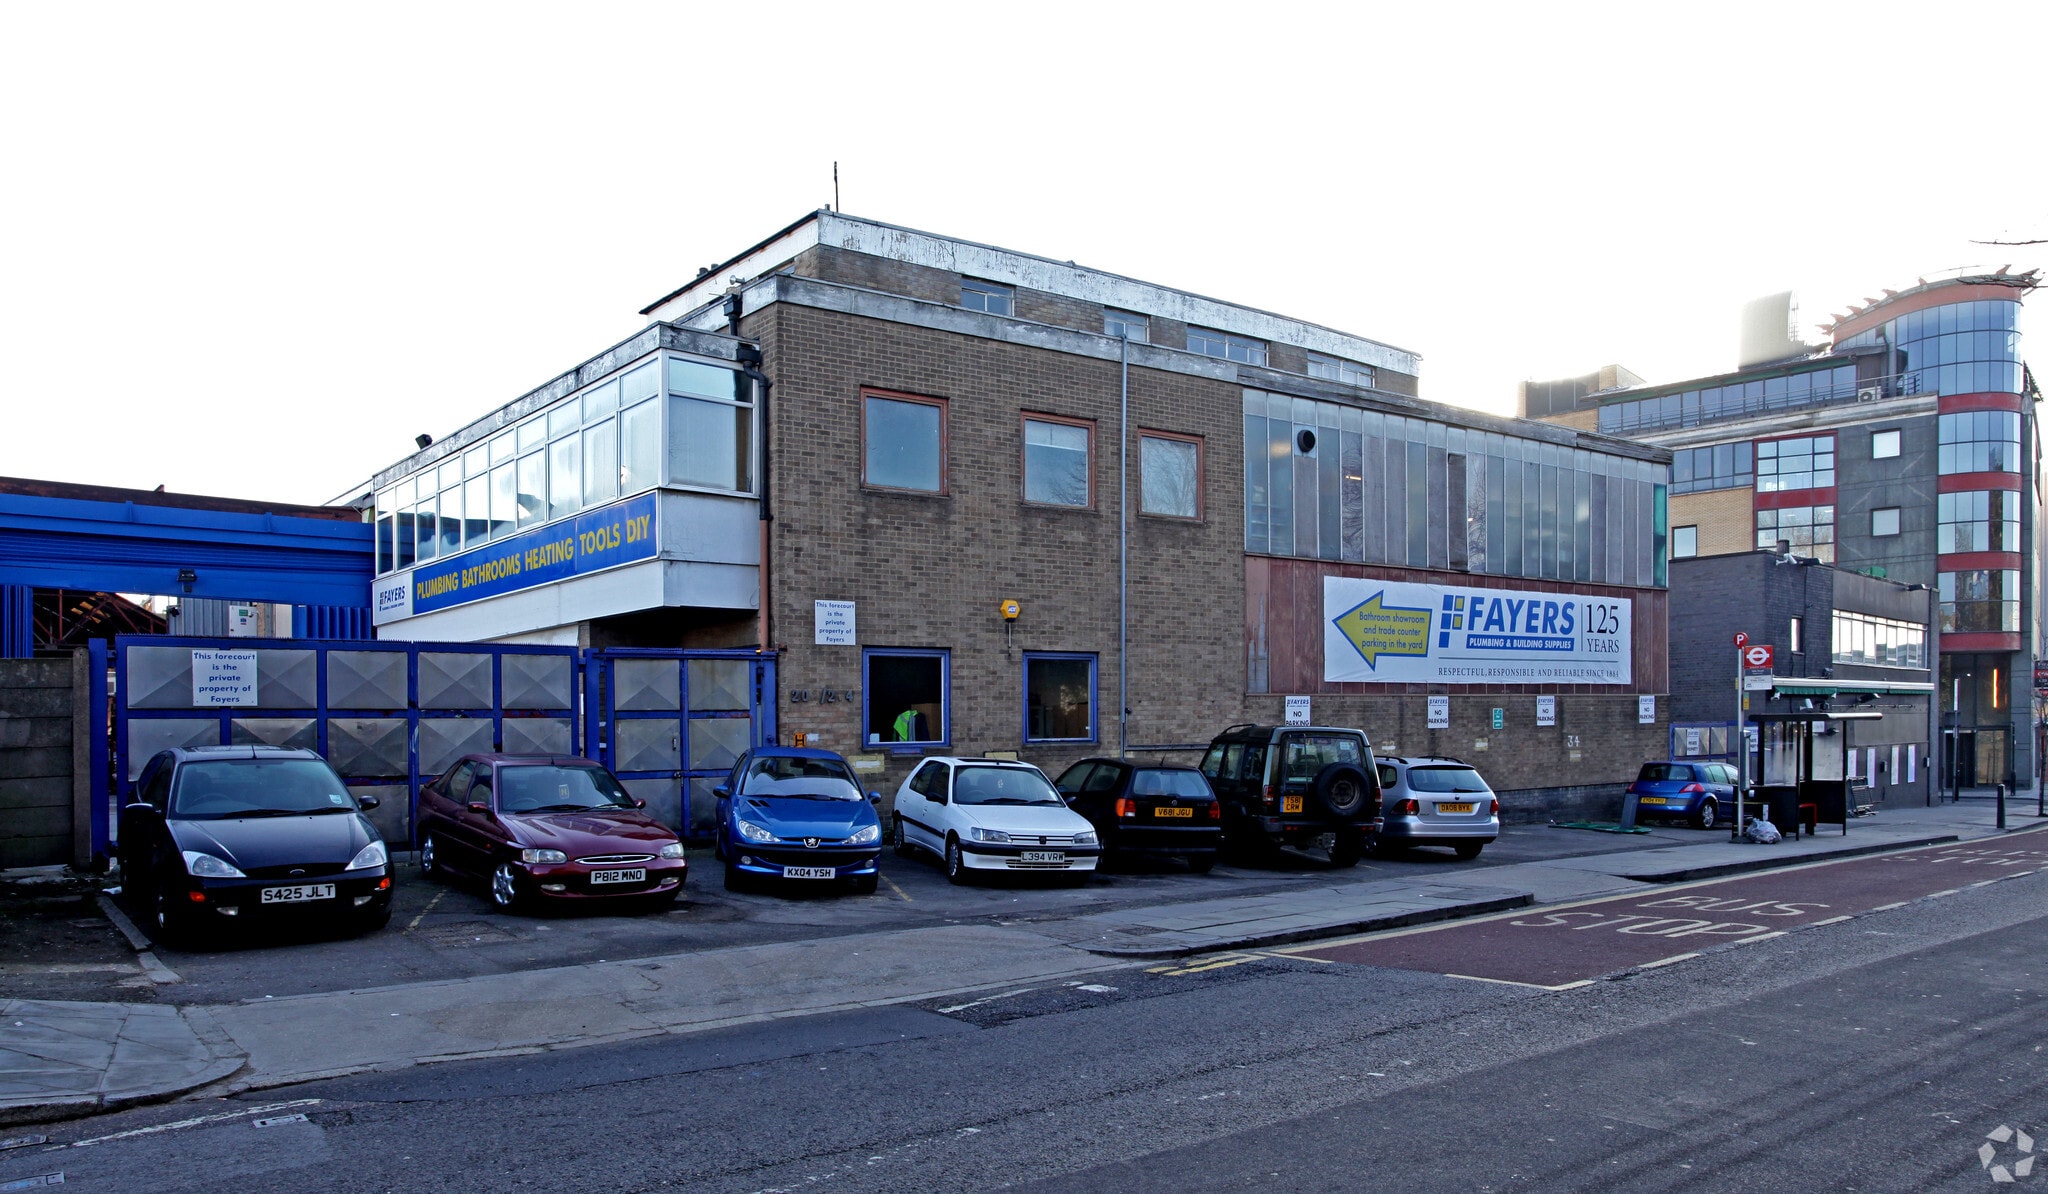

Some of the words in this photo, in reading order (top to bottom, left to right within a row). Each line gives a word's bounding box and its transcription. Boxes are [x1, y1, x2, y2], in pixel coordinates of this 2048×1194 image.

[417, 572, 458, 600] PLUMBING
[462, 553, 520, 588] BATHROOMS
[525, 538, 574, 571] HEATING
[580, 523, 620, 556] TOOLS
[626, 514, 650, 543] DIY
[384, 585, 405, 604] FAYERS
[1359, 611, 1390, 622] Bathroom
[1393, 612, 1425, 623] showroom
[1468, 596, 1575, 635] FAYERS
[1586, 603, 1619, 635] 125
[1364, 624, 1376, 634] and
[1379, 625, 1395, 635] trade
[1397, 628, 1421, 636] counter
[1362, 638, 1387, 650] parking
[1389, 639, 1394, 648] in
[1397, 639, 1406, 648] the
[1408, 640, 1423, 651] yard
[1469, 637, 1504, 648] PLUMBING
[1506, 639, 1511, 647] &
[1513, 639, 1543, 649] BUILDING
[1545, 640, 1571, 650] SUPPLIES
[1587, 638, 1620, 653] YEARS
[1736, 634, 1744, 645] P
[194, 652, 211, 660] This
[209, 674, 241, 682] private
[1538, 669, 1552, 677] AND
[1554, 669, 1584, 677] RELIABLE
[199, 685, 239, 693] property
[211, 695, 240, 703] Fayers
[1567, 735, 1580, 748] 34
[1286, 796, 1301, 804] T581
[1158, 808, 1174, 816] V681
[1021, 852, 1045, 861] L394
[594, 871, 619, 882] P812
[621, 870, 642, 881] MNO
[787, 868, 811, 877] KX04
[813, 868, 831, 877] YSH
[264, 887, 302, 901] S425
[306, 884, 334, 898] JLT
[1636, 896, 1831, 915] BUS
[1510, 912, 1771, 937] STOP
